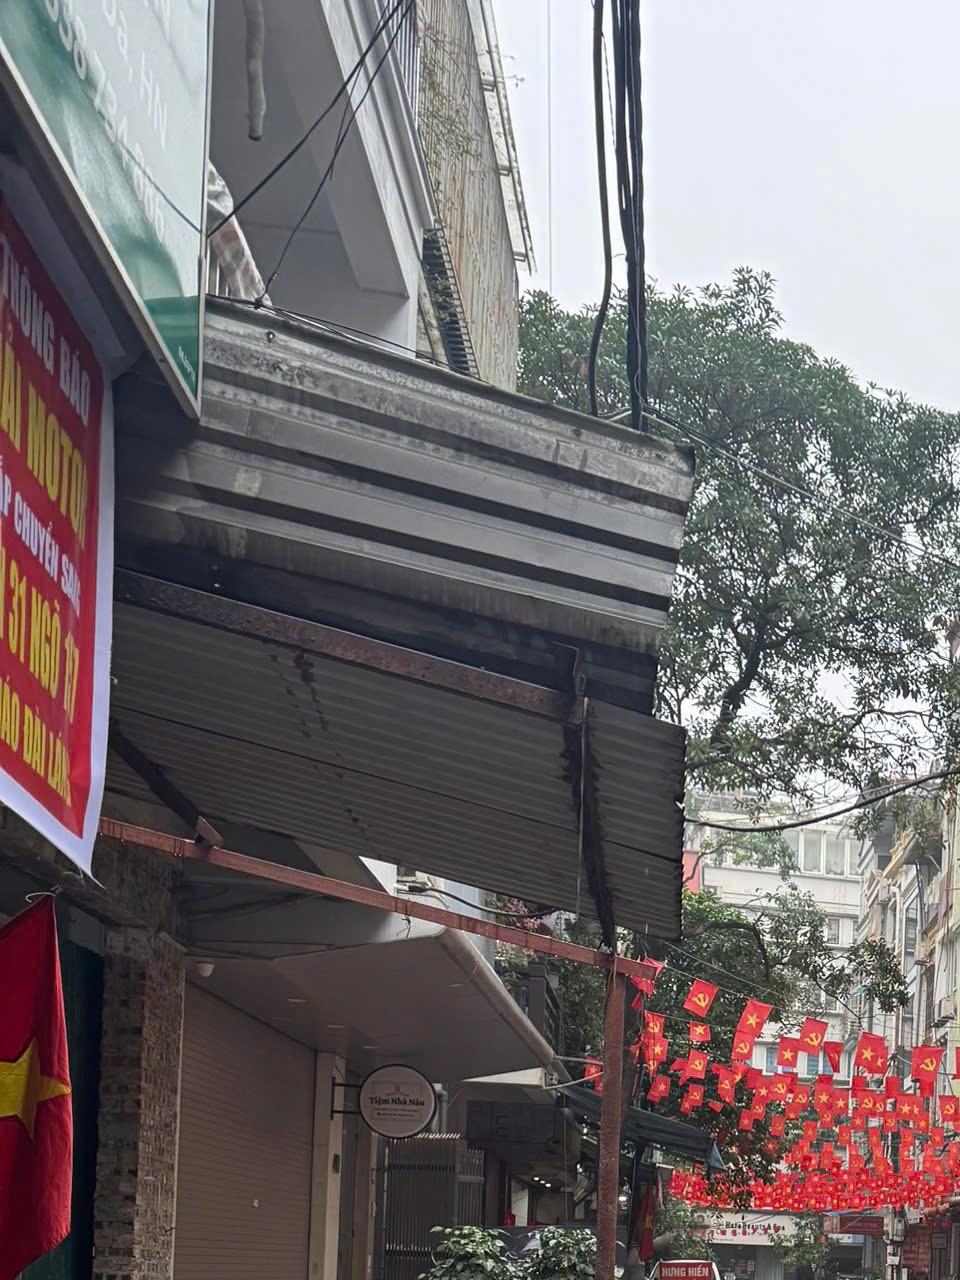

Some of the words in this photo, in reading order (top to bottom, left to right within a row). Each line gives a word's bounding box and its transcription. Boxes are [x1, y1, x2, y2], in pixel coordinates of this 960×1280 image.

[0, 321, 22, 453] ẢI
[1, 231, 55, 375] THÔNG
[60, 334, 90, 428] BÁO
[8, 559, 26, 664] 31
[0, 676, 20, 752] ÁO
